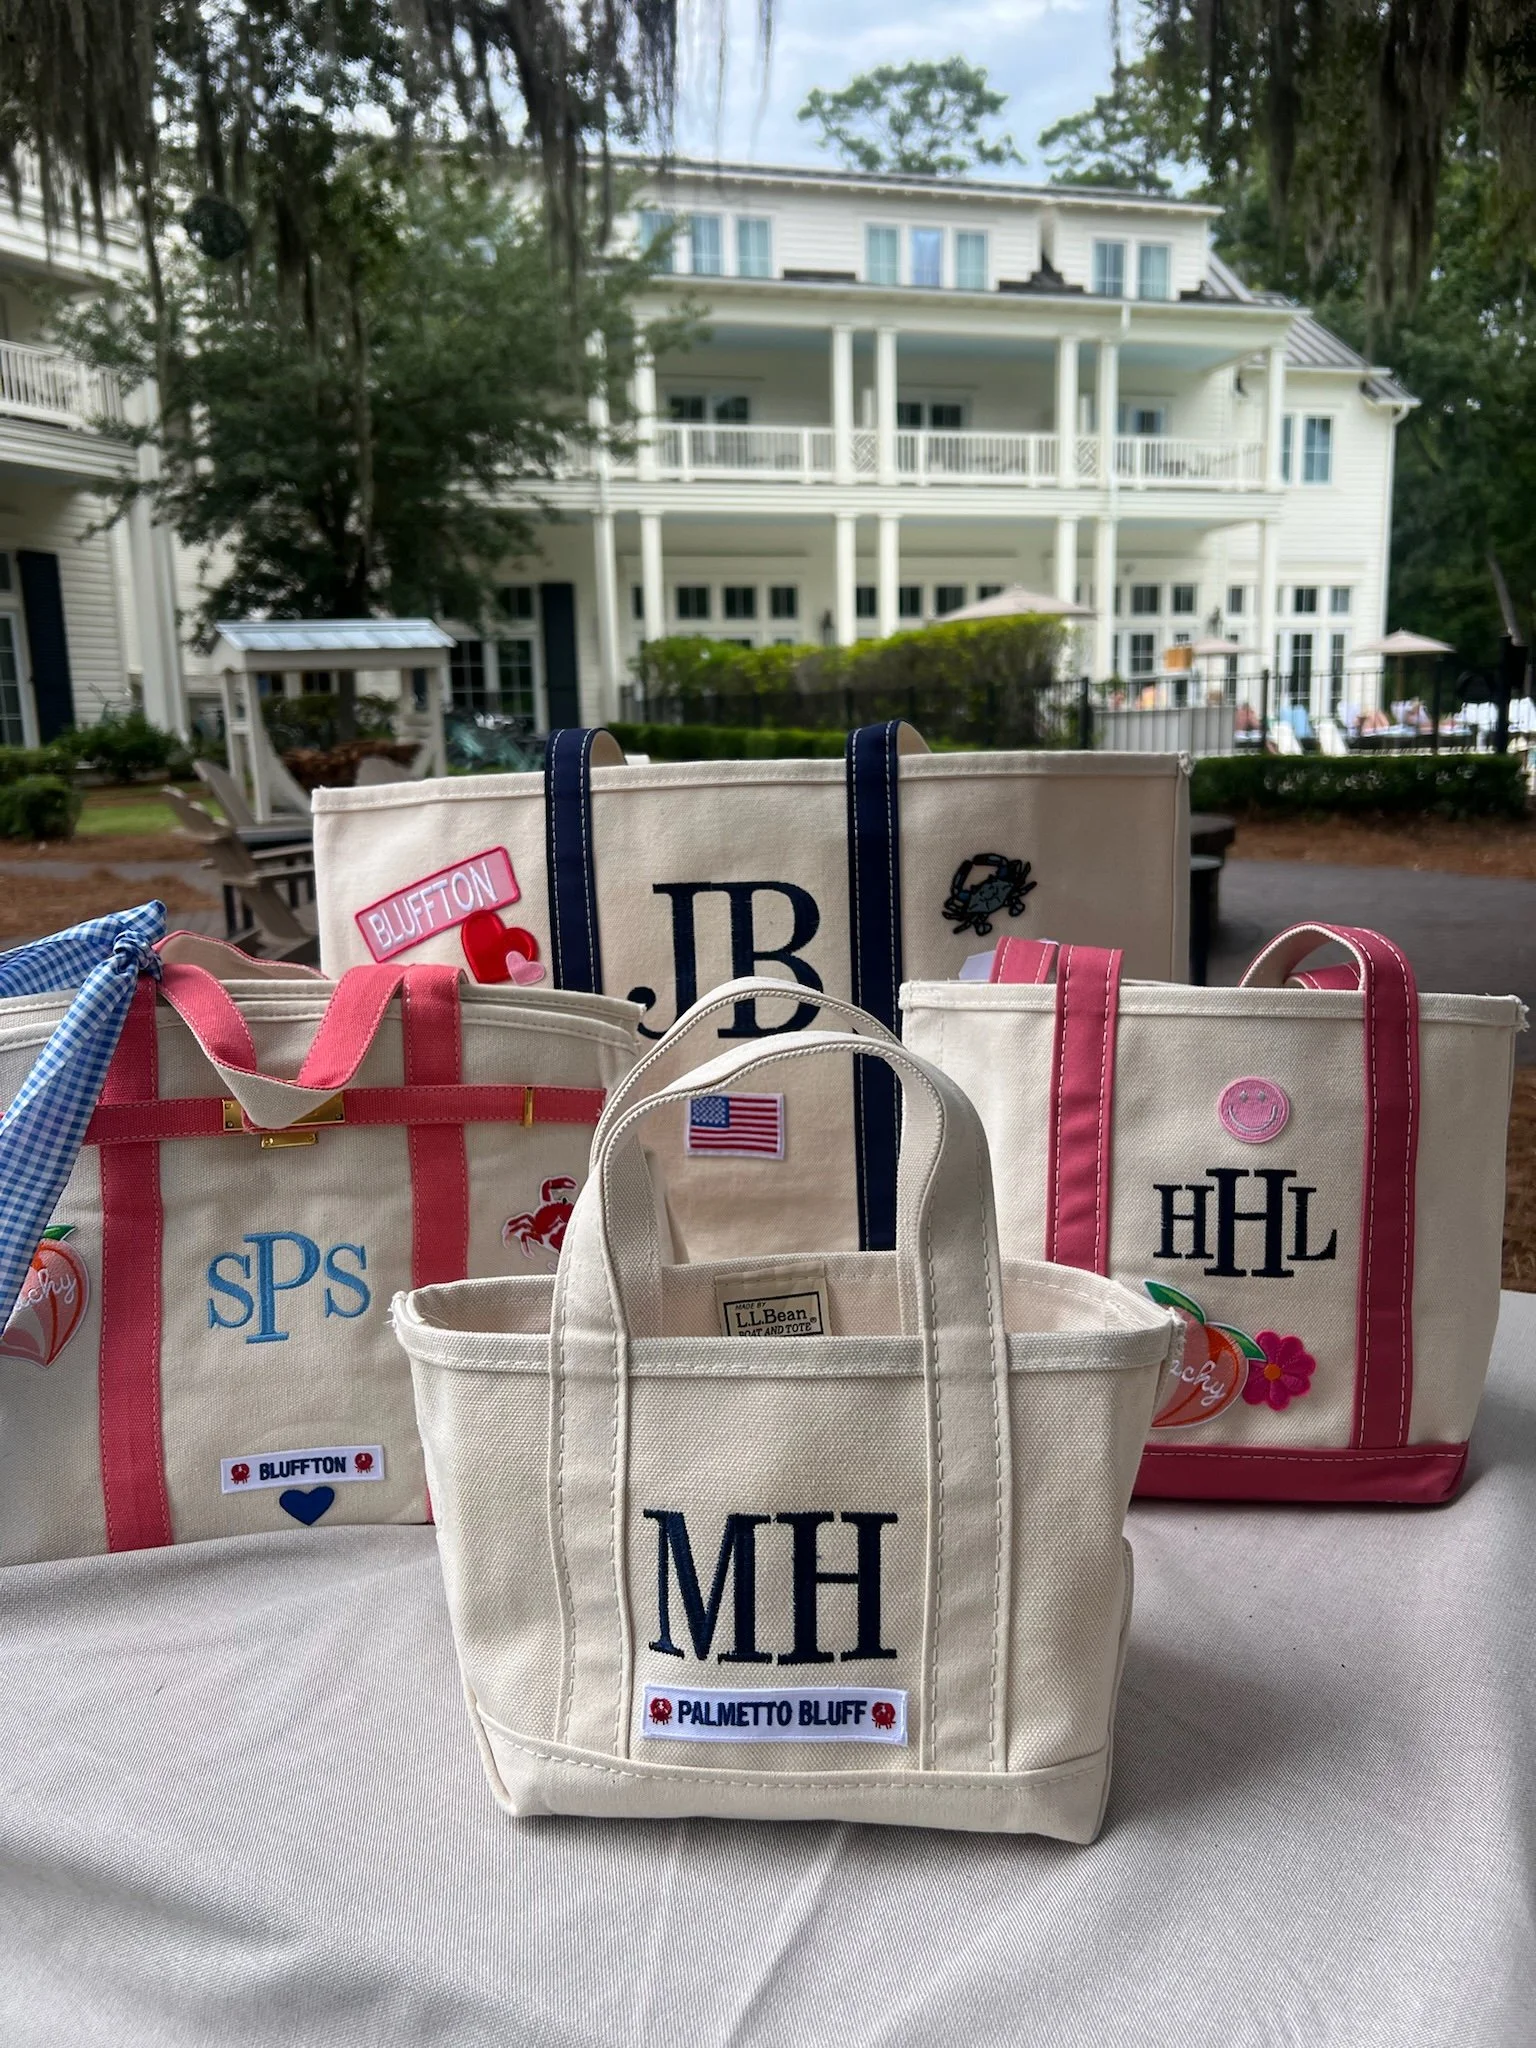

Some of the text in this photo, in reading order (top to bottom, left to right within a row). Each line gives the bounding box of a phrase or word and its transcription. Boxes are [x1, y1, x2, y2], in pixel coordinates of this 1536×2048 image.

[368, 861, 498, 948] BLUFFTON
[627, 881, 824, 1040] JB
[1153, 1168, 1337, 1278] HHL
[764, 1326, 784, 1337] AND
[785, 1322, 812, 1334] TOTE
[259, 1456, 347, 1481] BLUFFTON
[643, 1508, 898, 1665] MH
[678, 1699, 868, 1726] PALMETTO BLUFF
